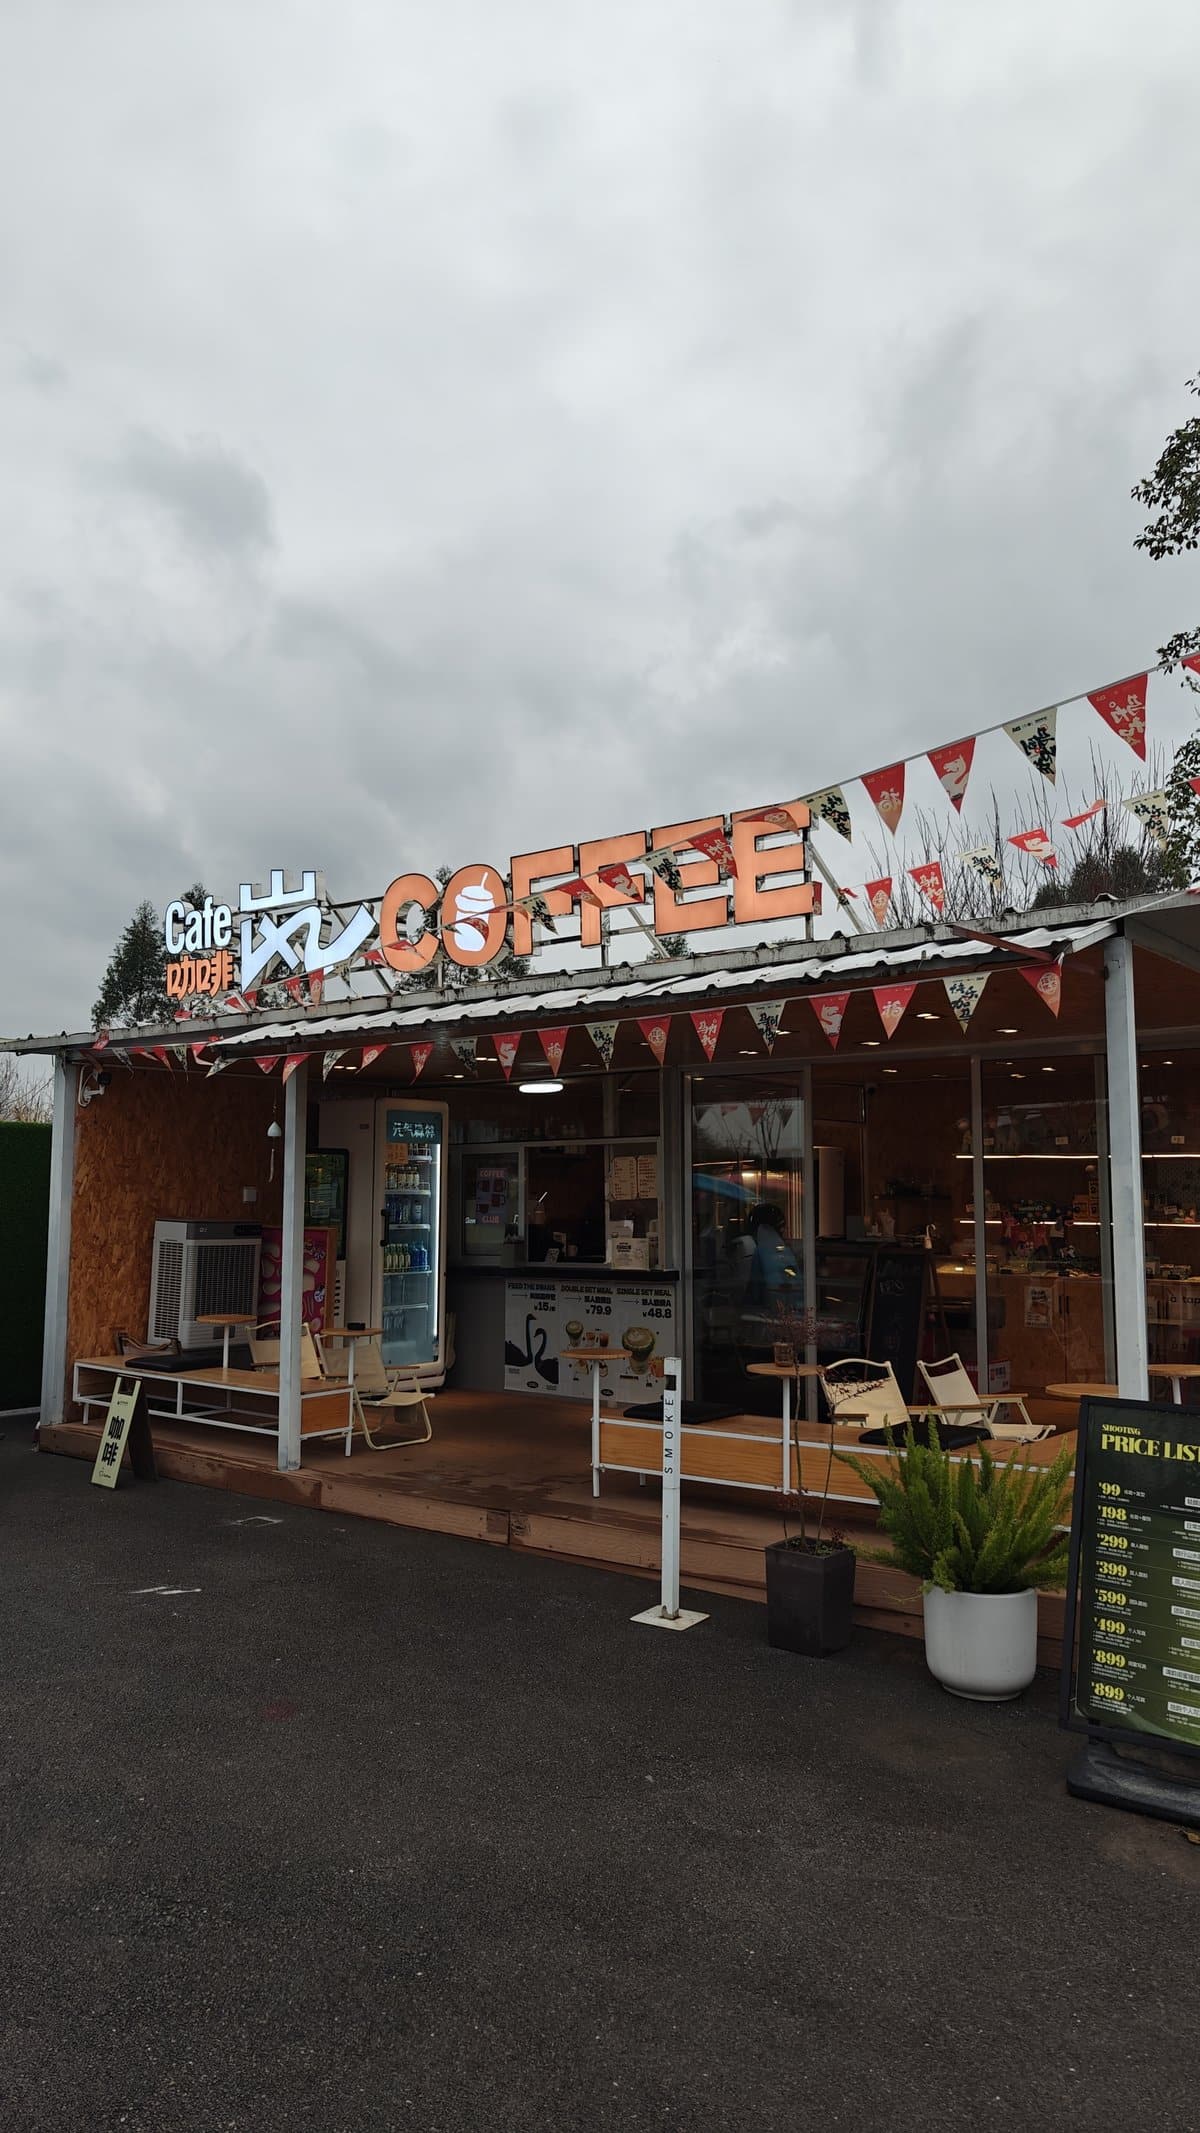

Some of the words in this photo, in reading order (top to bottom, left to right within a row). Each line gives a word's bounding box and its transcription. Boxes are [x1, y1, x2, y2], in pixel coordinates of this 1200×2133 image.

[381, 799, 813, 974] COFFEE
[165, 895, 232, 954] Cafe
[166, 949, 235, 1001] 咖啡
[642, 1307, 672, 1319] ¥48.8
[101, 1415, 125, 1466] 咖啡
[664, 1399, 674, 1474] SMOKE
[1101, 1423, 1141, 1436] SHOOTING
[1101, 1433, 1160, 1457] PRICE
